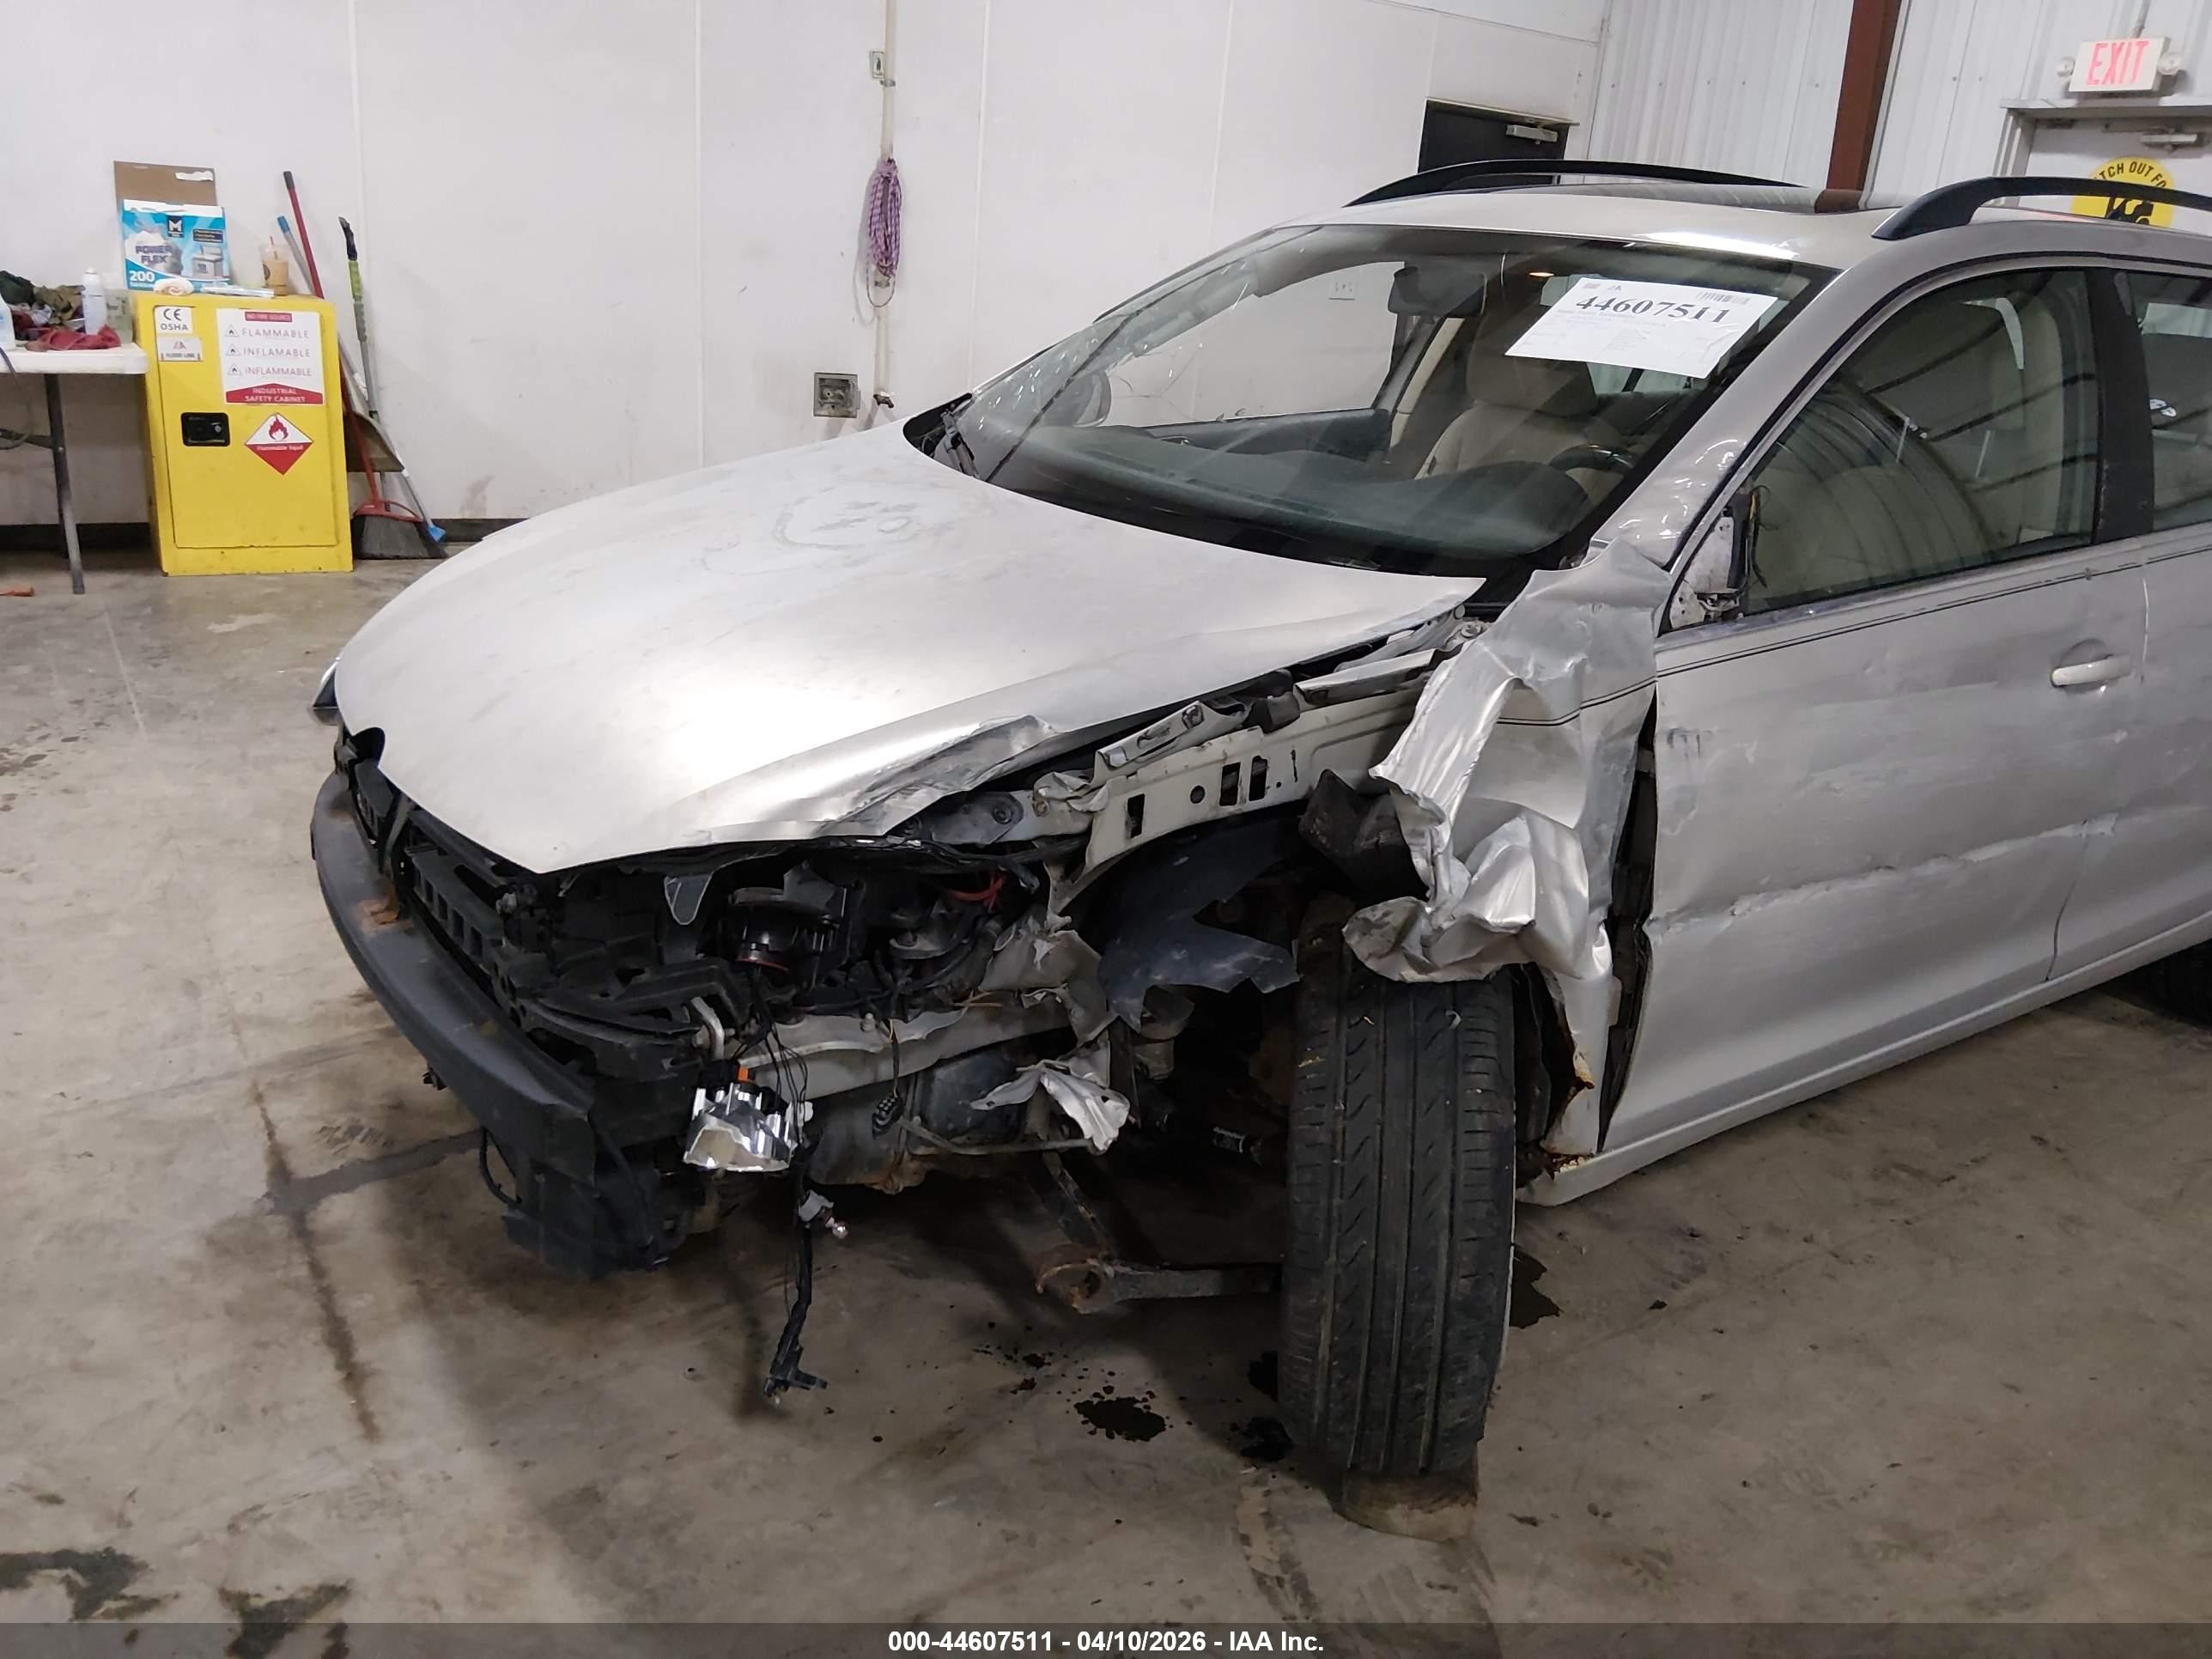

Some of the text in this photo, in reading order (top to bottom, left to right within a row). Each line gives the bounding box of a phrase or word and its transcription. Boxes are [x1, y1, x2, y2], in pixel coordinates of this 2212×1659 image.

[2087, 40, 2149, 85] EXIT
[2130, 161, 2154, 177] OUT
[2150, 173, 2166, 188] FO
[130, 270, 155, 282] 200
[163, 308, 182, 321] CE
[1575, 296, 1730, 323] 44607511
[242, 328, 309, 338] FLAMMABLE
[244, 347, 310, 357] INFLAMABLE
[246, 367, 312, 377] INFLAMMABLE
